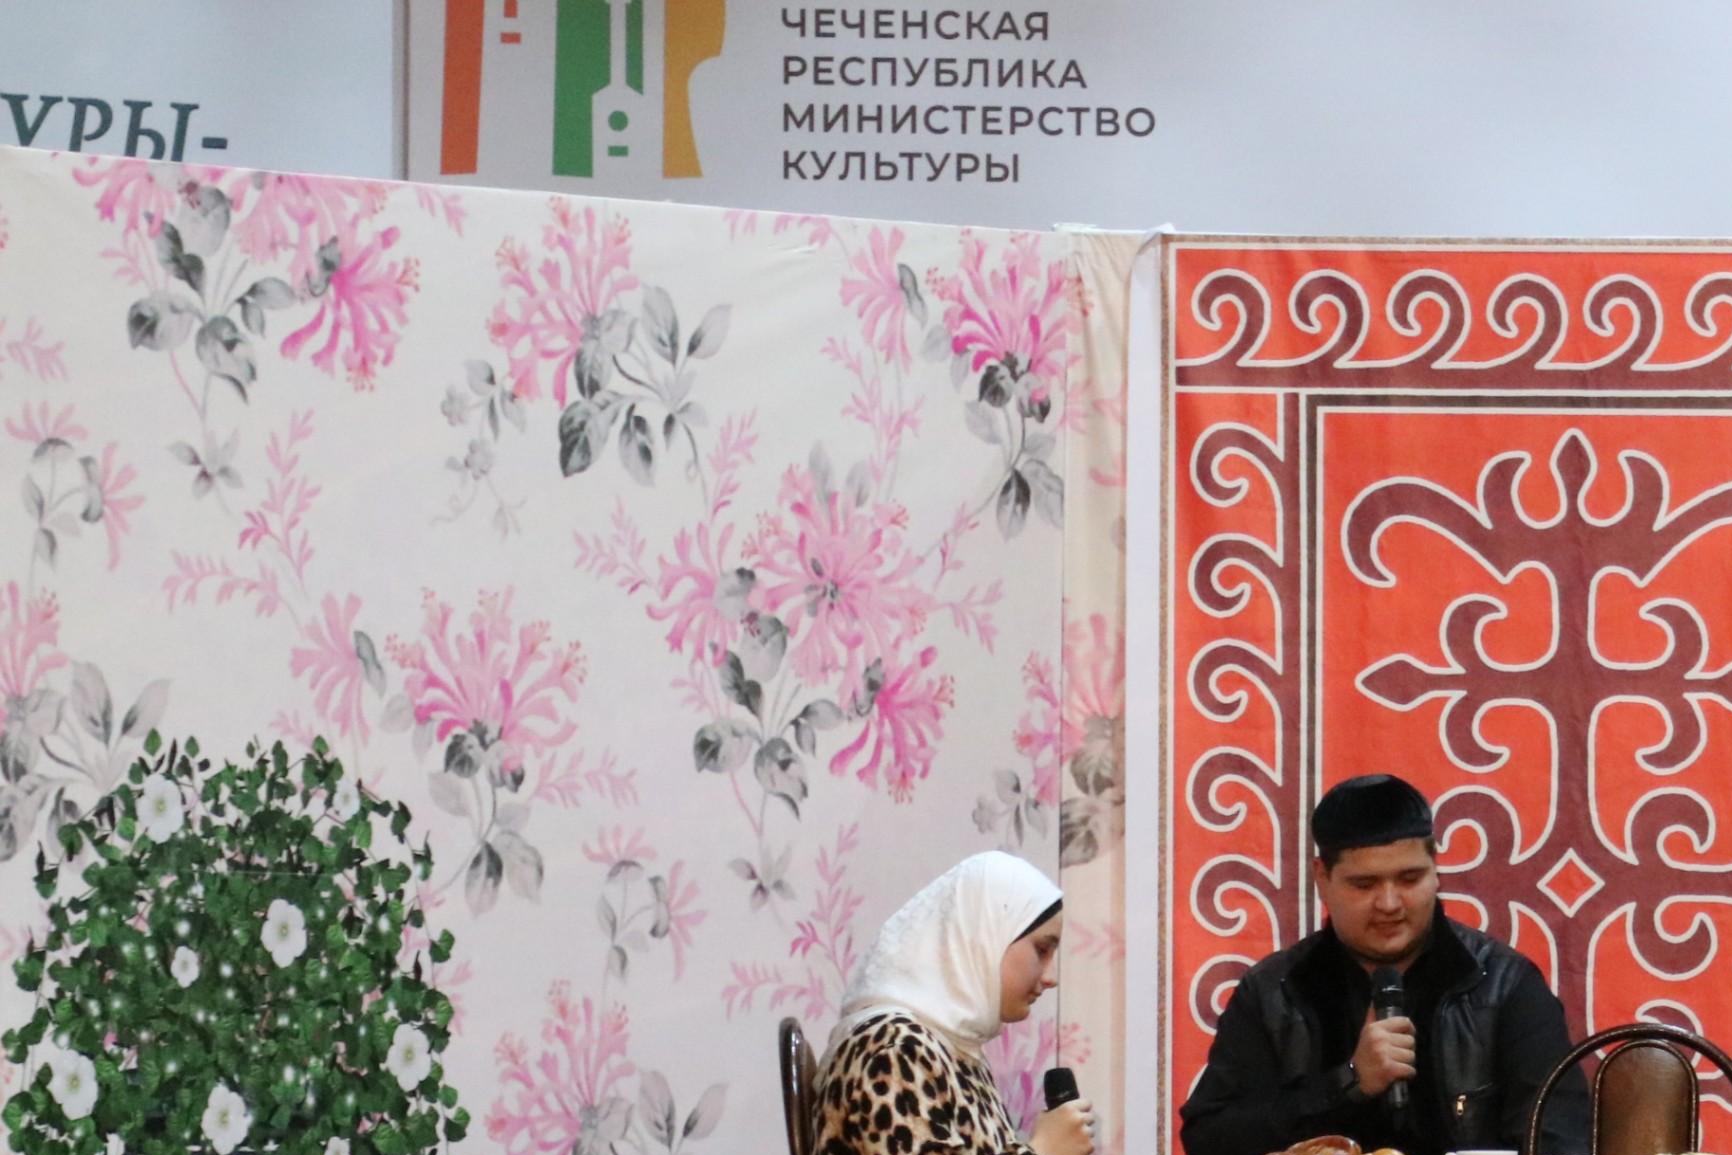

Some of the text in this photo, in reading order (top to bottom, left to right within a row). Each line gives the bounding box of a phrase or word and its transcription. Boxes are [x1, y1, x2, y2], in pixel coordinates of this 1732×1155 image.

[781, 9, 1050, 41] ЧЕЧЕНСКАЯ
[782, 56, 1088, 89] РЕСПУБЛИКА
[782, 104, 1156, 138] МИНИСТЕРСТВО
[782, 151, 1020, 183] КУЛЬТУРЫ
